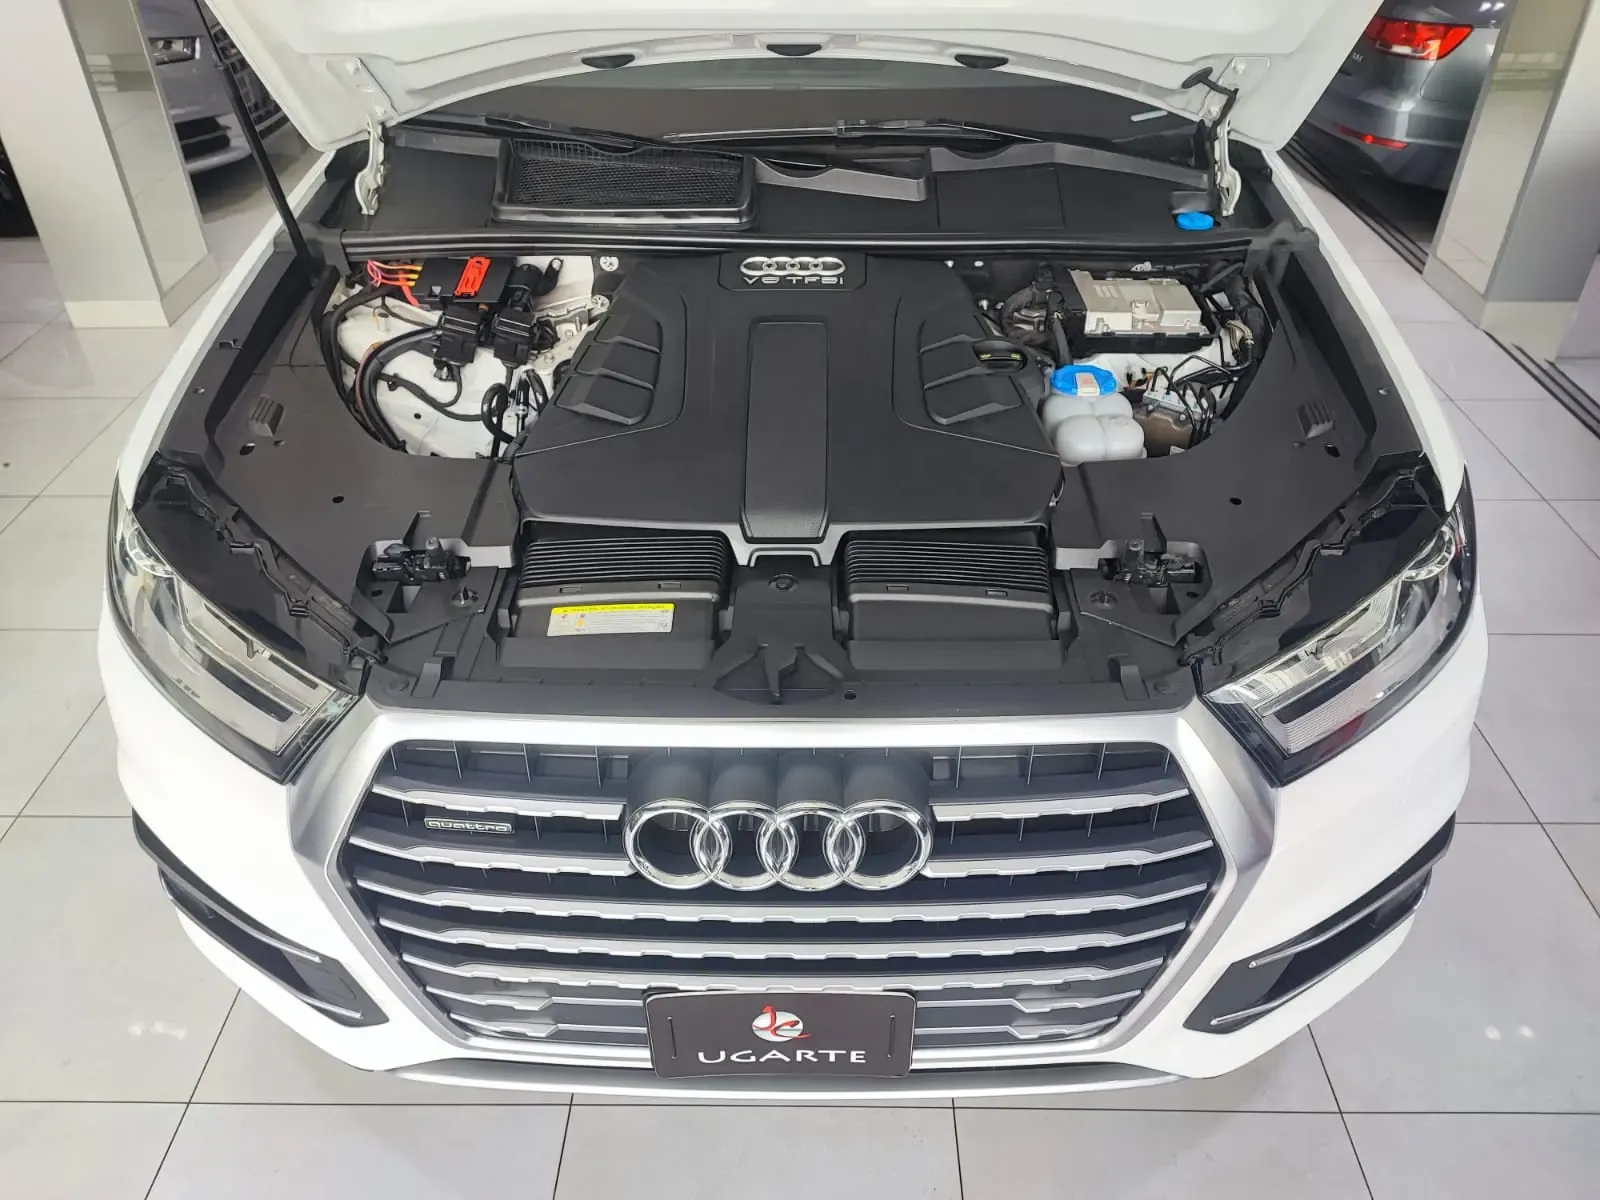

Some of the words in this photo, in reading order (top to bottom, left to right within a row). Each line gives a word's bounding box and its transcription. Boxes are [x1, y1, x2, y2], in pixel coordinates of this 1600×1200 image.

[786, 276, 844, 285] TFSI
[428, 821, 508, 832] quattro
[698, 1050, 866, 1063] UGARTE
